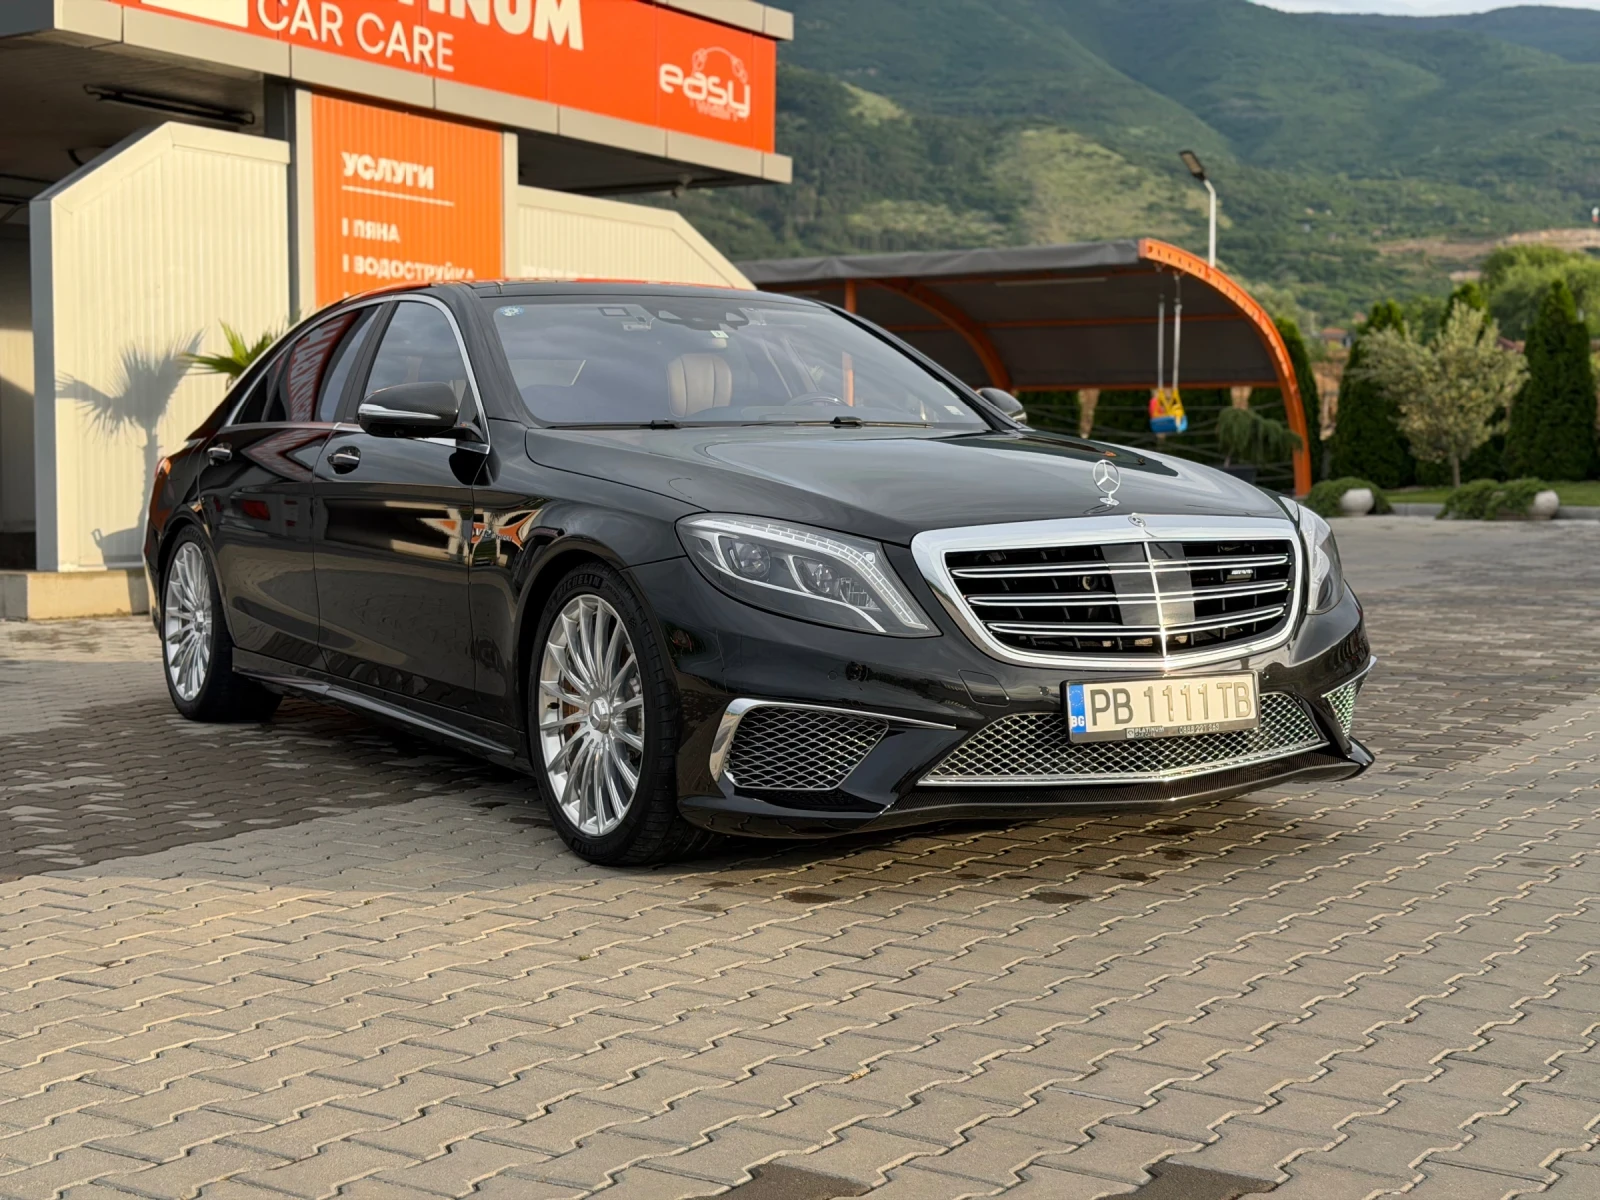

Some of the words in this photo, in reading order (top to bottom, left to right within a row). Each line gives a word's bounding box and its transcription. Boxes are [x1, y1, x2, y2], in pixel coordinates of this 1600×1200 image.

[256, 0, 343, 47] CAR
[356, 12, 455, 72] CARE
[659, 63, 751, 118] easy
[341, 151, 435, 191] УСЛУГИ
[353, 219, 401, 244] ПЯНА
[555, 573, 601, 600] MICHELIN
[1071, 715, 1085, 728] BG
[1089, 687, 1134, 726] PB
